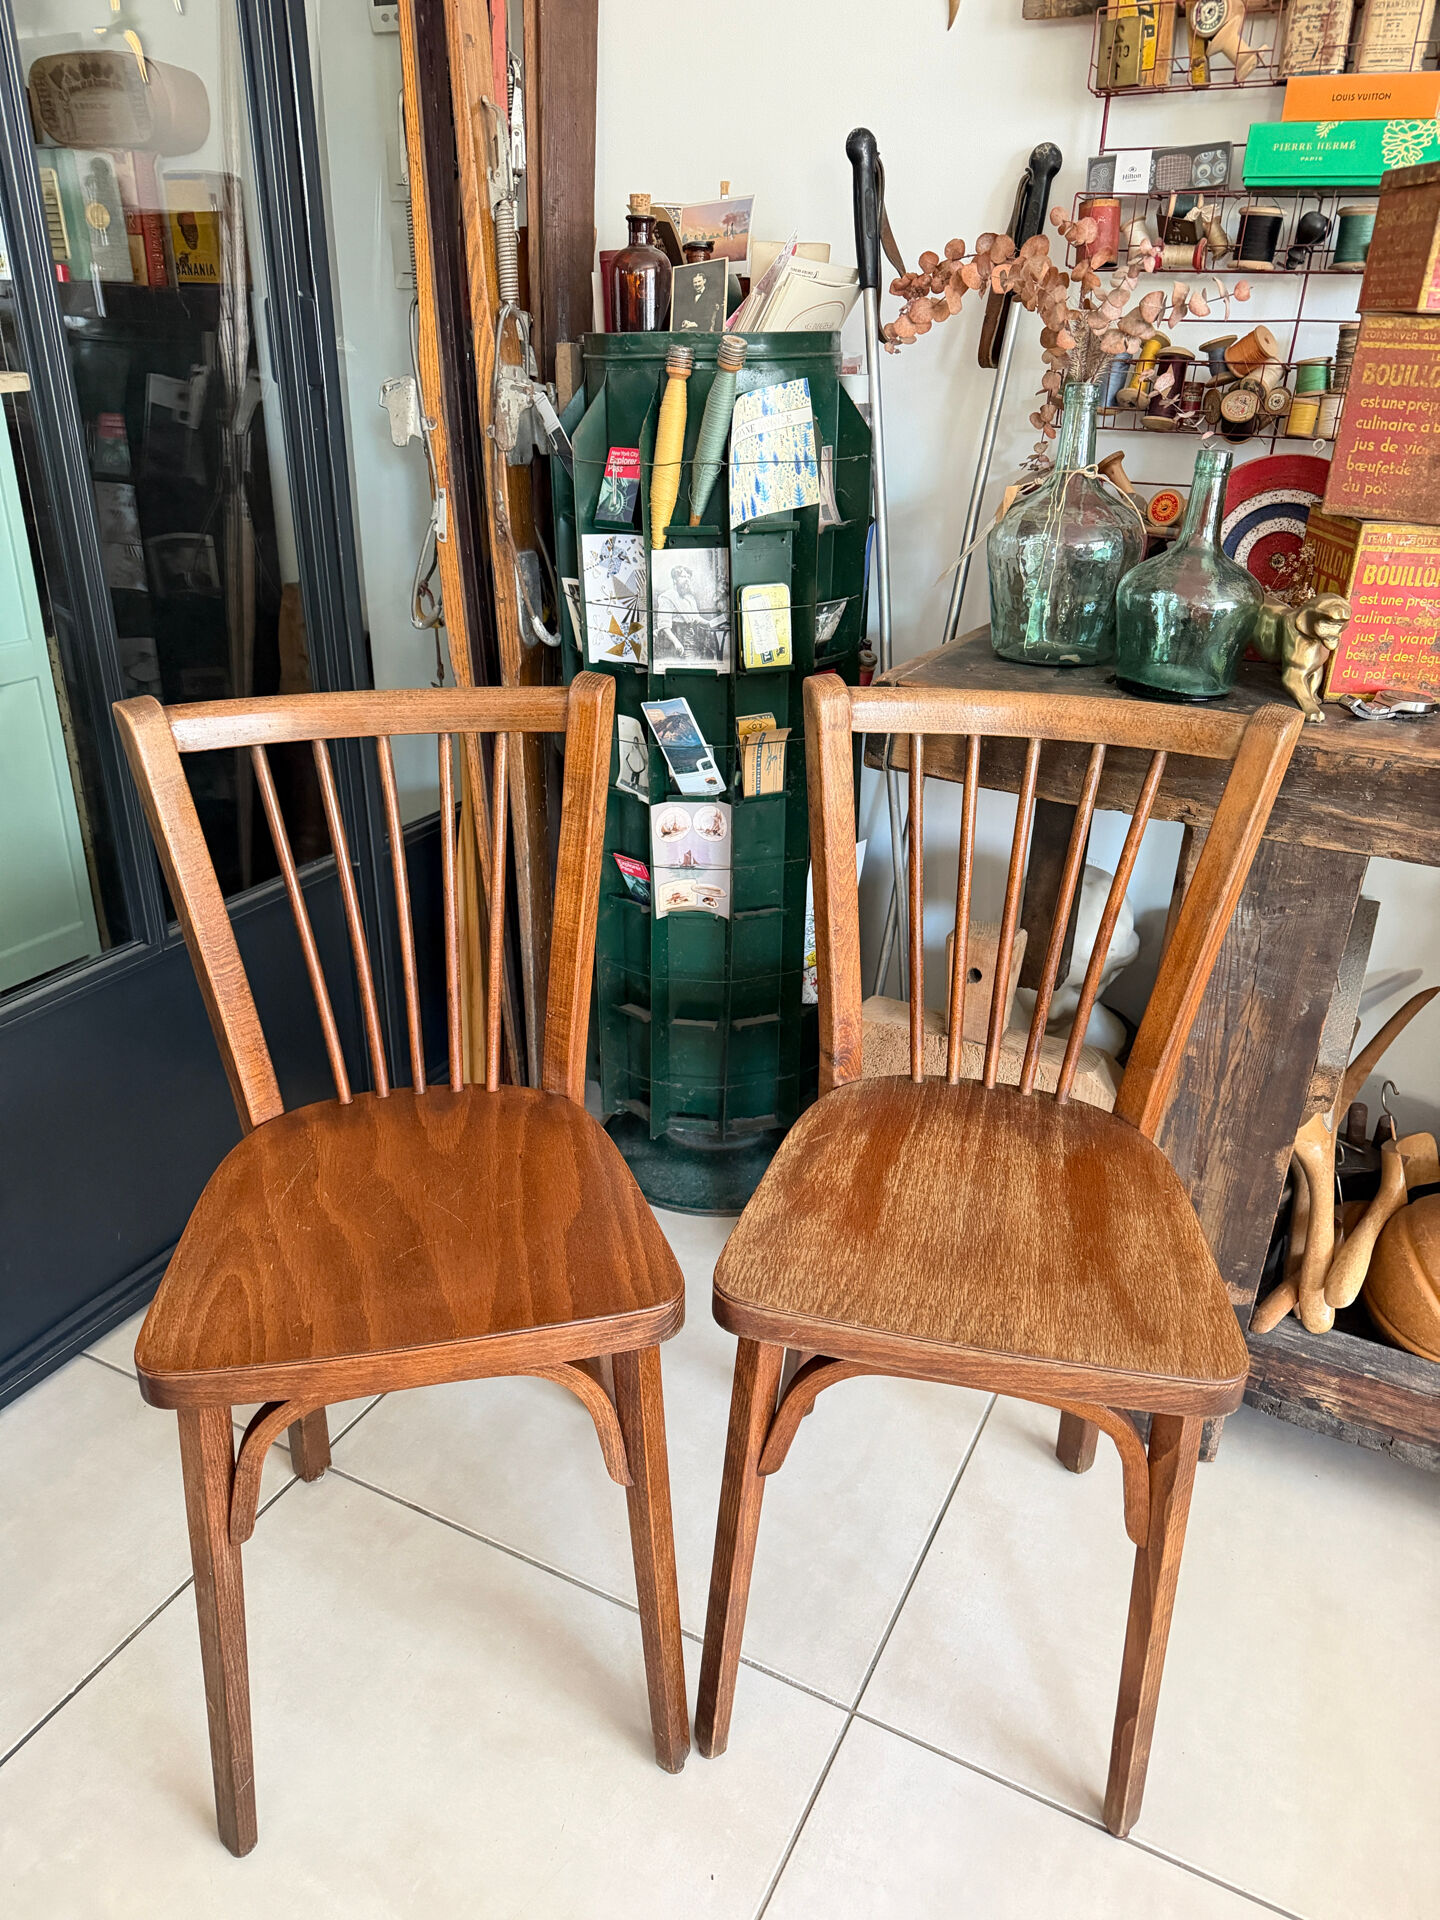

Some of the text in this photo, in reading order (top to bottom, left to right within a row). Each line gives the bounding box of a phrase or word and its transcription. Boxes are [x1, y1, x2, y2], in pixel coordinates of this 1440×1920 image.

[1331, 92, 1392, 102] LOUIS VUITTON
[1273, 139, 1357, 152] PIERRE HERMÉ
[1122, 173, 1142, 181] Hilton
[175, 261, 217, 277] BANANIA
[1364, 330, 1437, 341] CONSERVER AU
[1360, 395, 1380, 409] est
[1381, 398, 1406, 410] une
[1356, 414, 1417, 433] culinaire
[1350, 436, 1375, 453] jus
[1380, 436, 1399, 453] de
[609, 455, 637, 465] Explorer
[1367, 534, 1393, 545] TENIR
[1424, 556, 1436, 565] LE
[1360, 593, 1378, 605] est
[1381, 596, 1404, 606] une
[1351, 629, 1376, 645] jus
[1379, 628, 1395, 643] de
[1379, 649, 1392, 662] et
[1393, 648, 1415, 662] des
[1342, 665, 1360, 679] du
